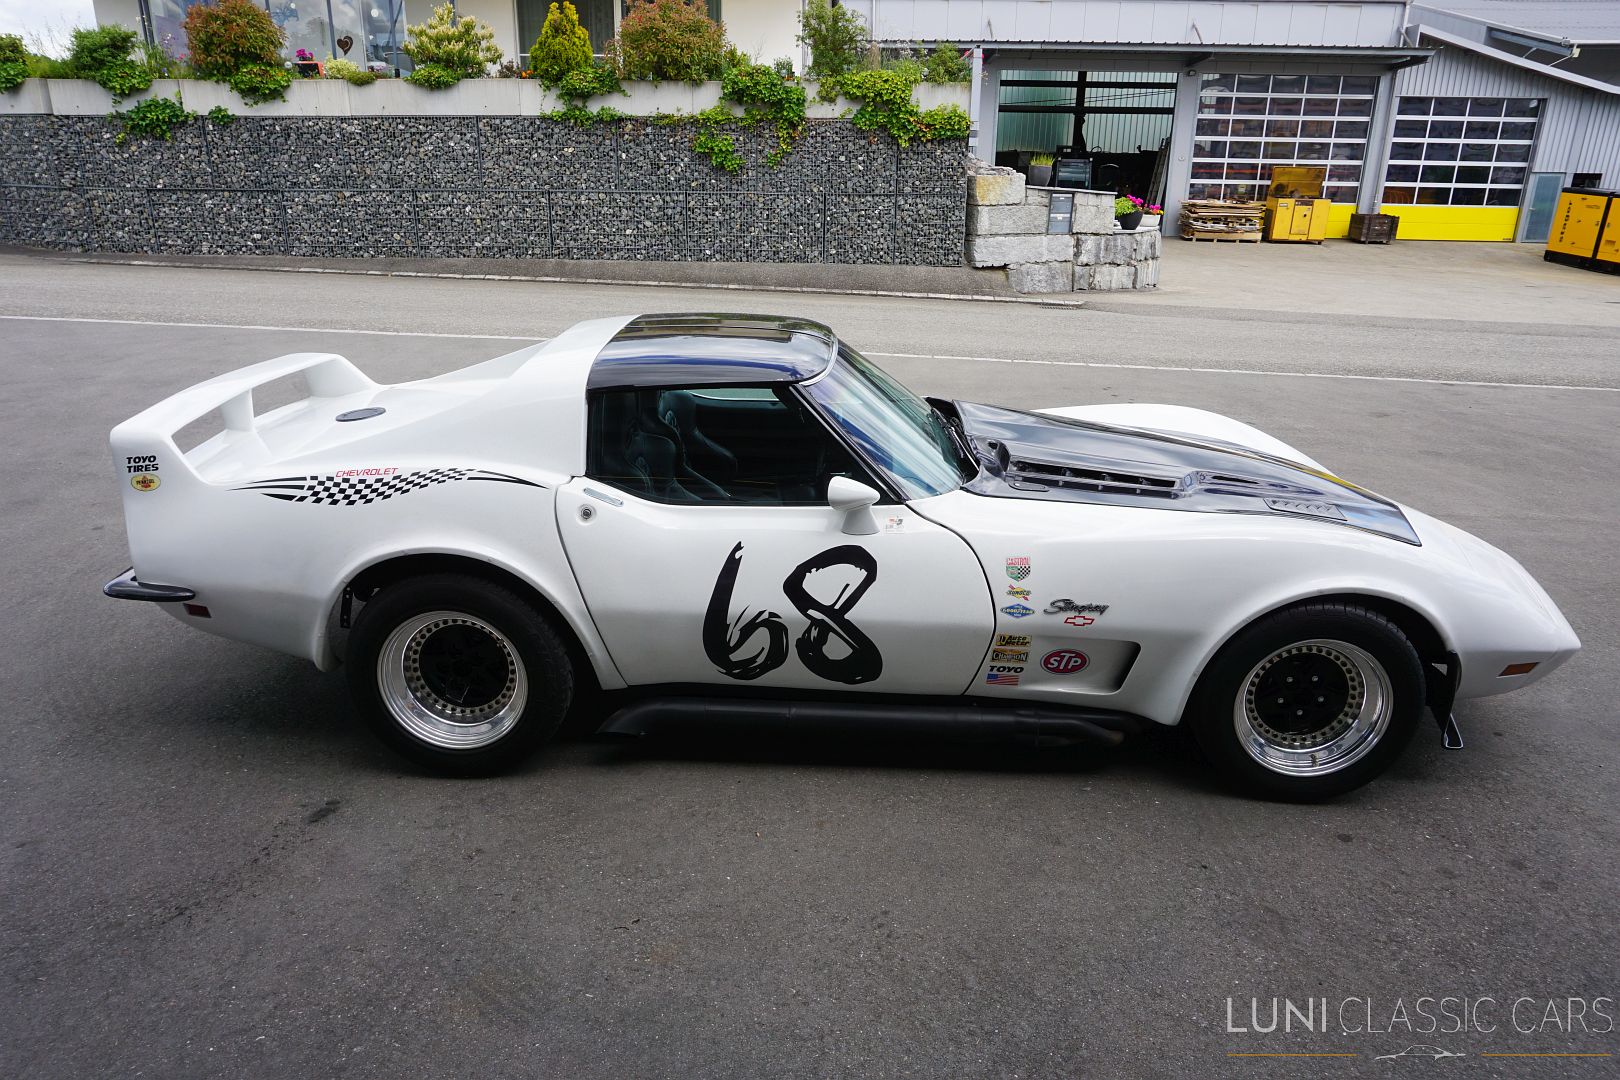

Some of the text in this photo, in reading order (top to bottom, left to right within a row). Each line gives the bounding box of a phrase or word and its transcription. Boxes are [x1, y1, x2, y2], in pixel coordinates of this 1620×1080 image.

[126, 455, 156, 464] TOYO
[126, 464, 159, 473] TIRES
[335, 468, 398, 477] CHEVROLET
[702, 540, 883, 685] 68
[1047, 652, 1082, 670] STP
[989, 665, 1024, 673] TOYO
